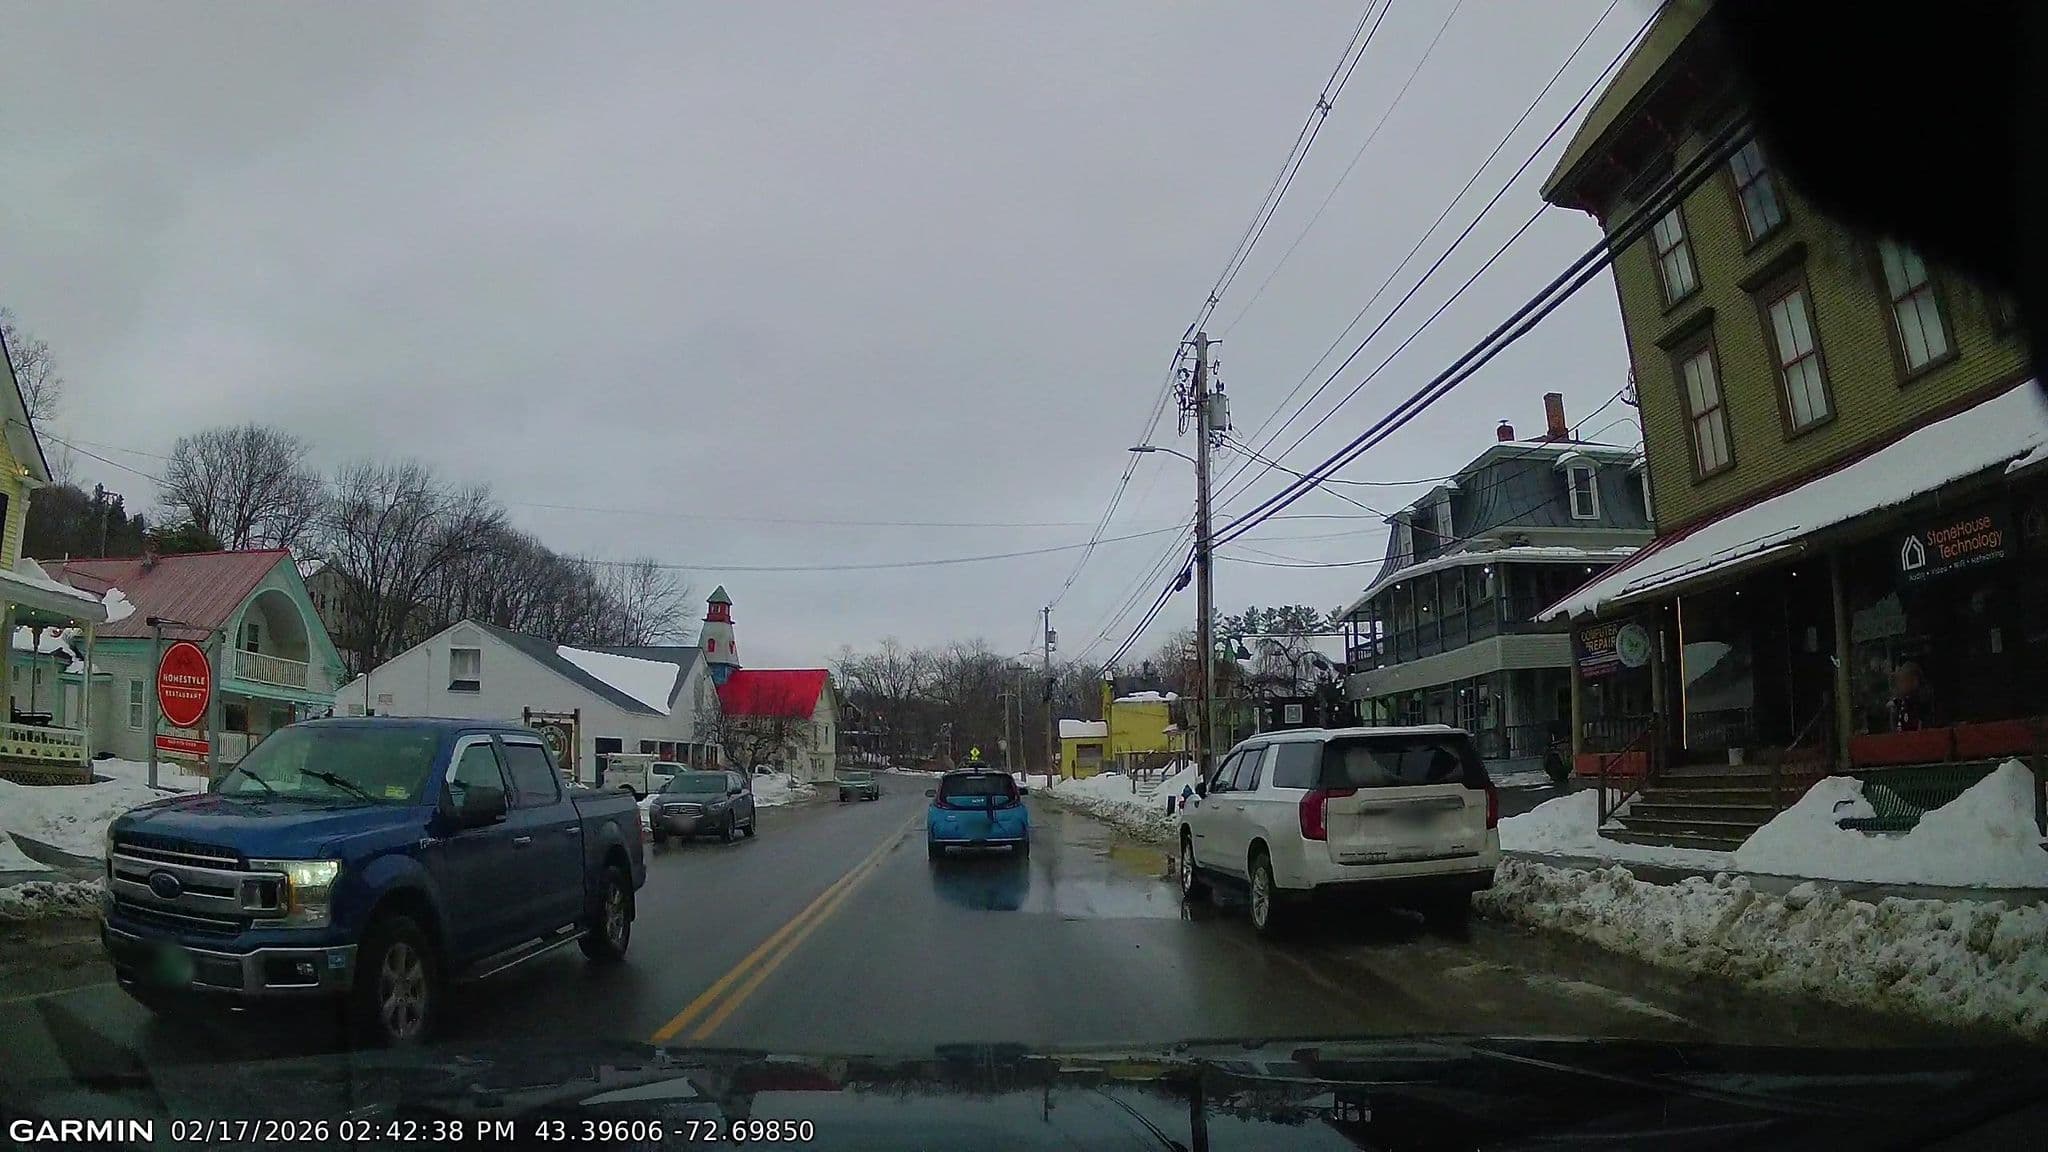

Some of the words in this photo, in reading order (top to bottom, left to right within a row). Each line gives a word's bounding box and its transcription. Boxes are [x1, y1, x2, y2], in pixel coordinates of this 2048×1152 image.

[1926, 516, 1991, 546] StoneHouse
[1940, 529, 2003, 559] Technology
[1581, 623, 1617, 641] COMPUTER
[1587, 635, 1616, 652] REPAIR
[163, 673, 205, 685] HOMESTYLE
[165, 690, 202, 700] RESTAURANT
